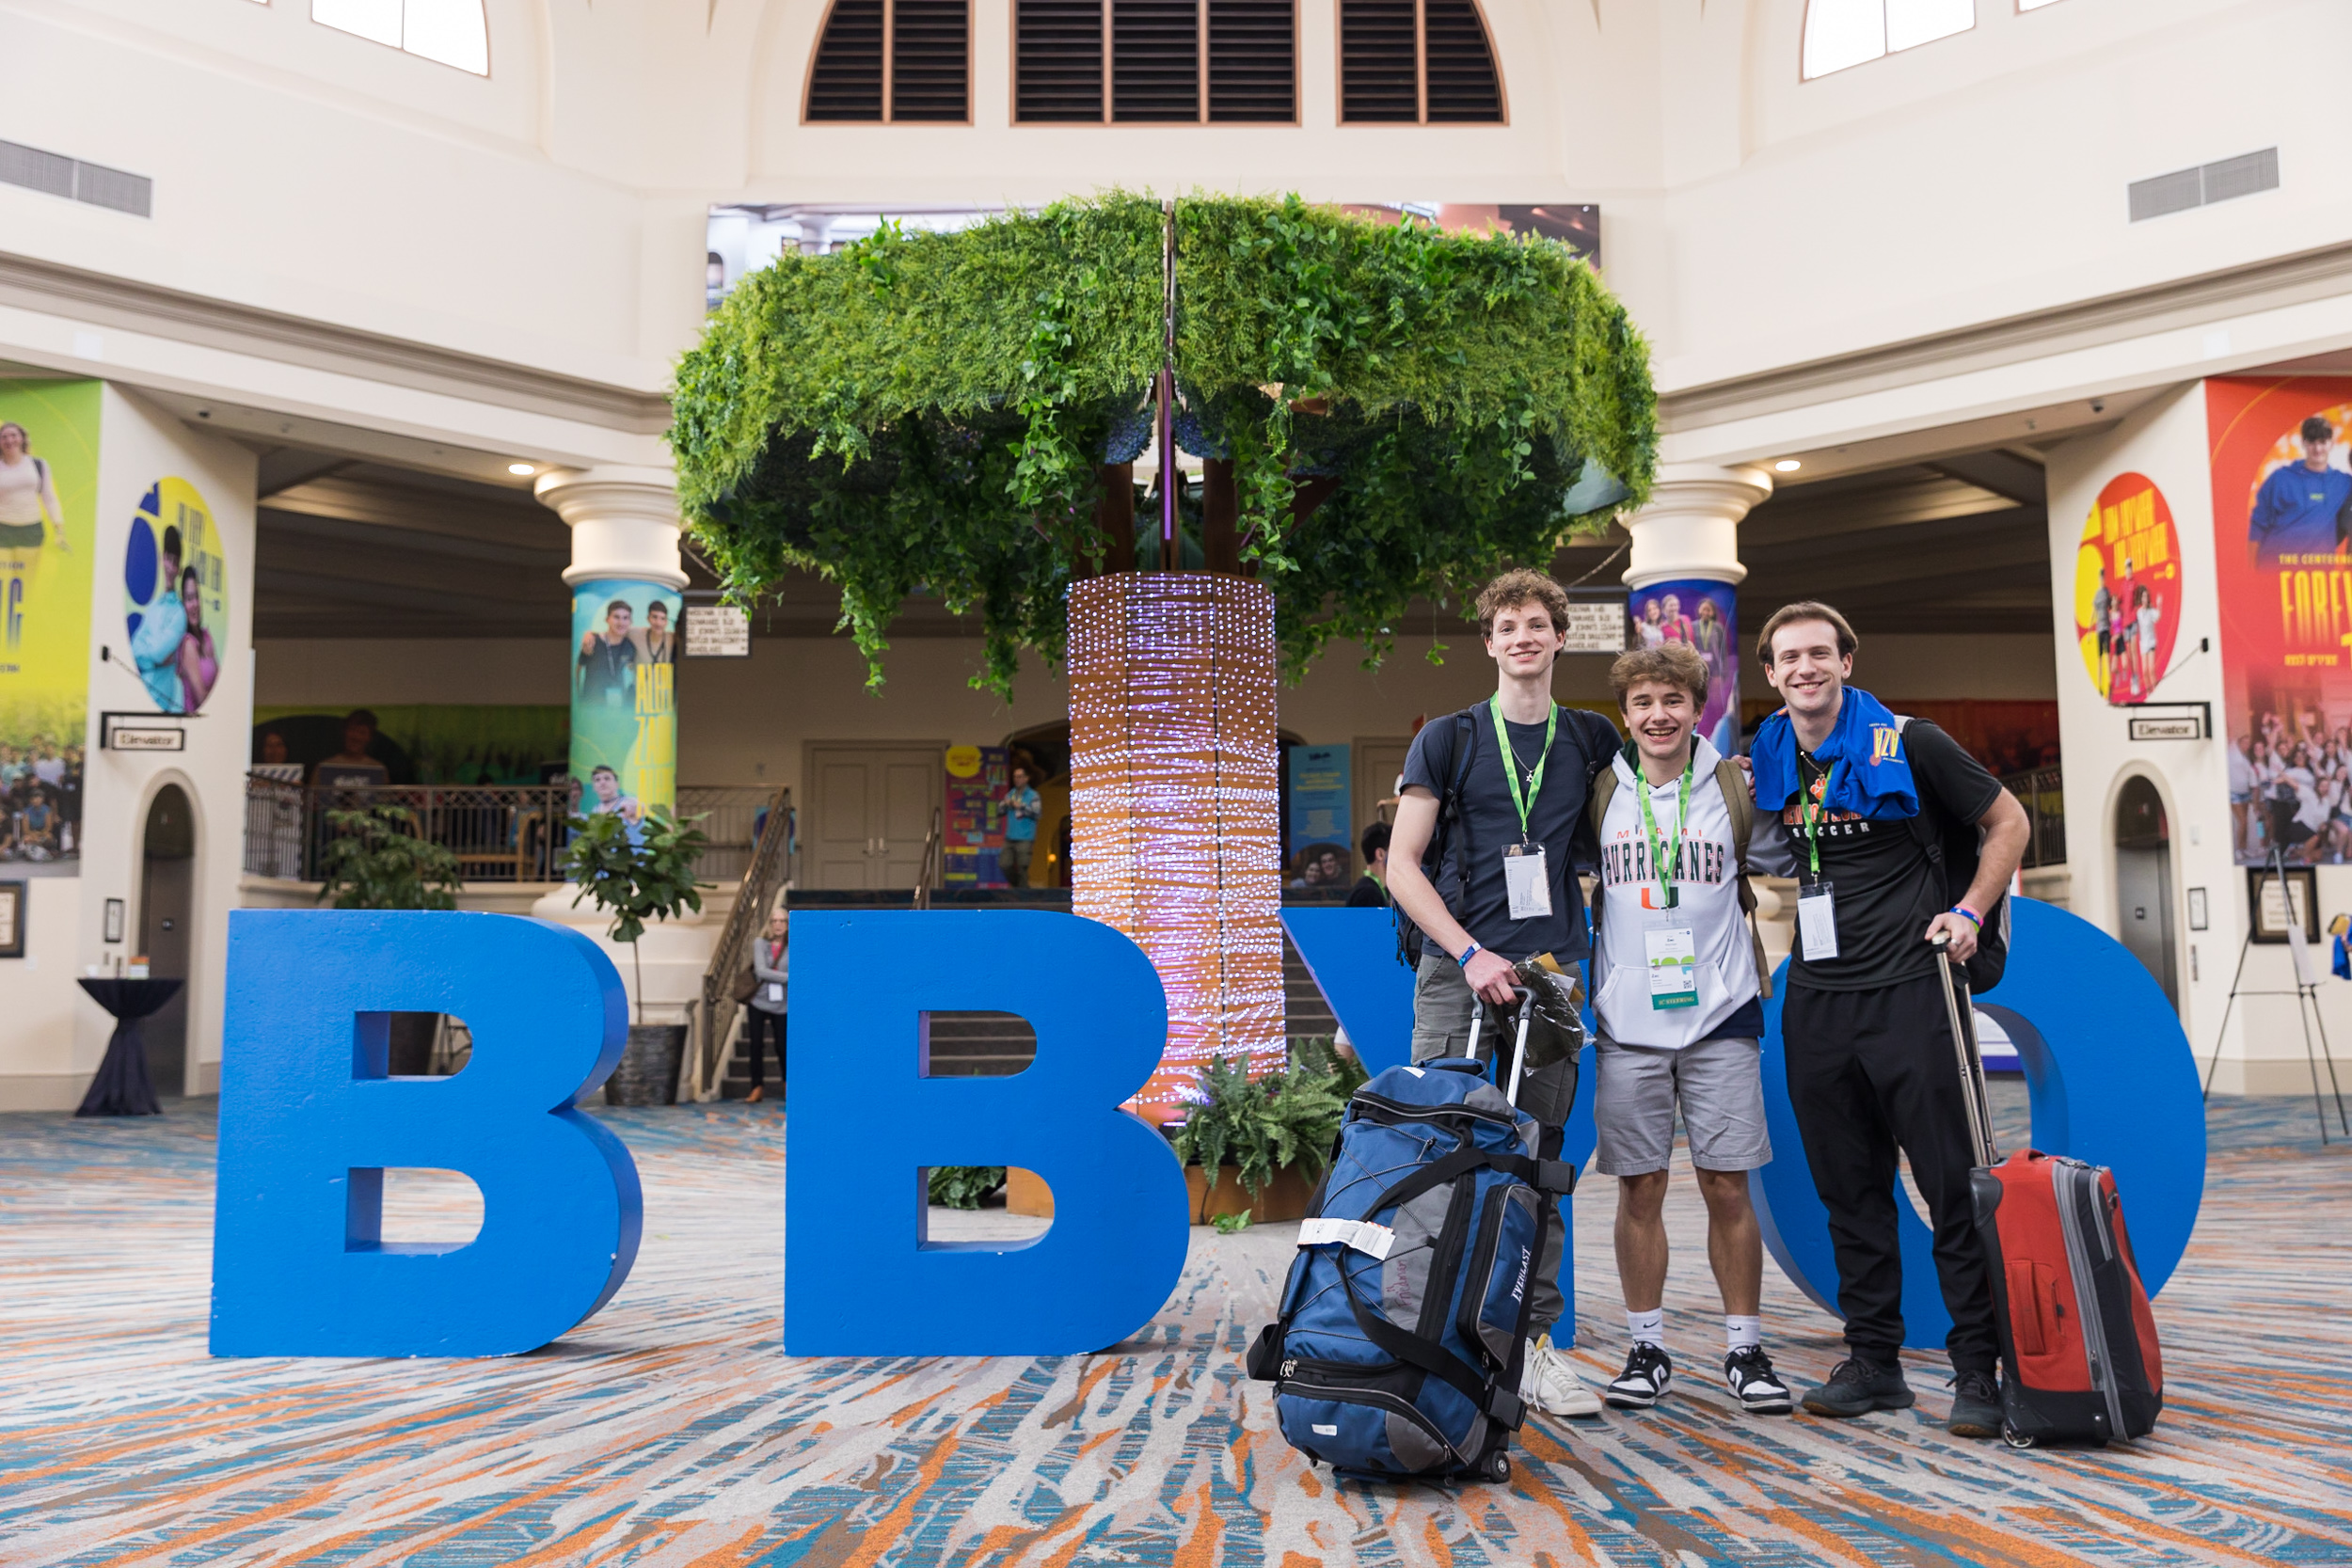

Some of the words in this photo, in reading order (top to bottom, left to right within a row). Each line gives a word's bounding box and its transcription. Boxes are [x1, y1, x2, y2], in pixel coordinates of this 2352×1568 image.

[2138, 723, 2189, 736] Elevator
[1616, 827, 1702, 840] MIAMI
[1792, 821, 1870, 838] SOCCER
[1602, 838, 1724, 889] HURRICANES
[1511, 1244, 1533, 1306] EVERLAST
